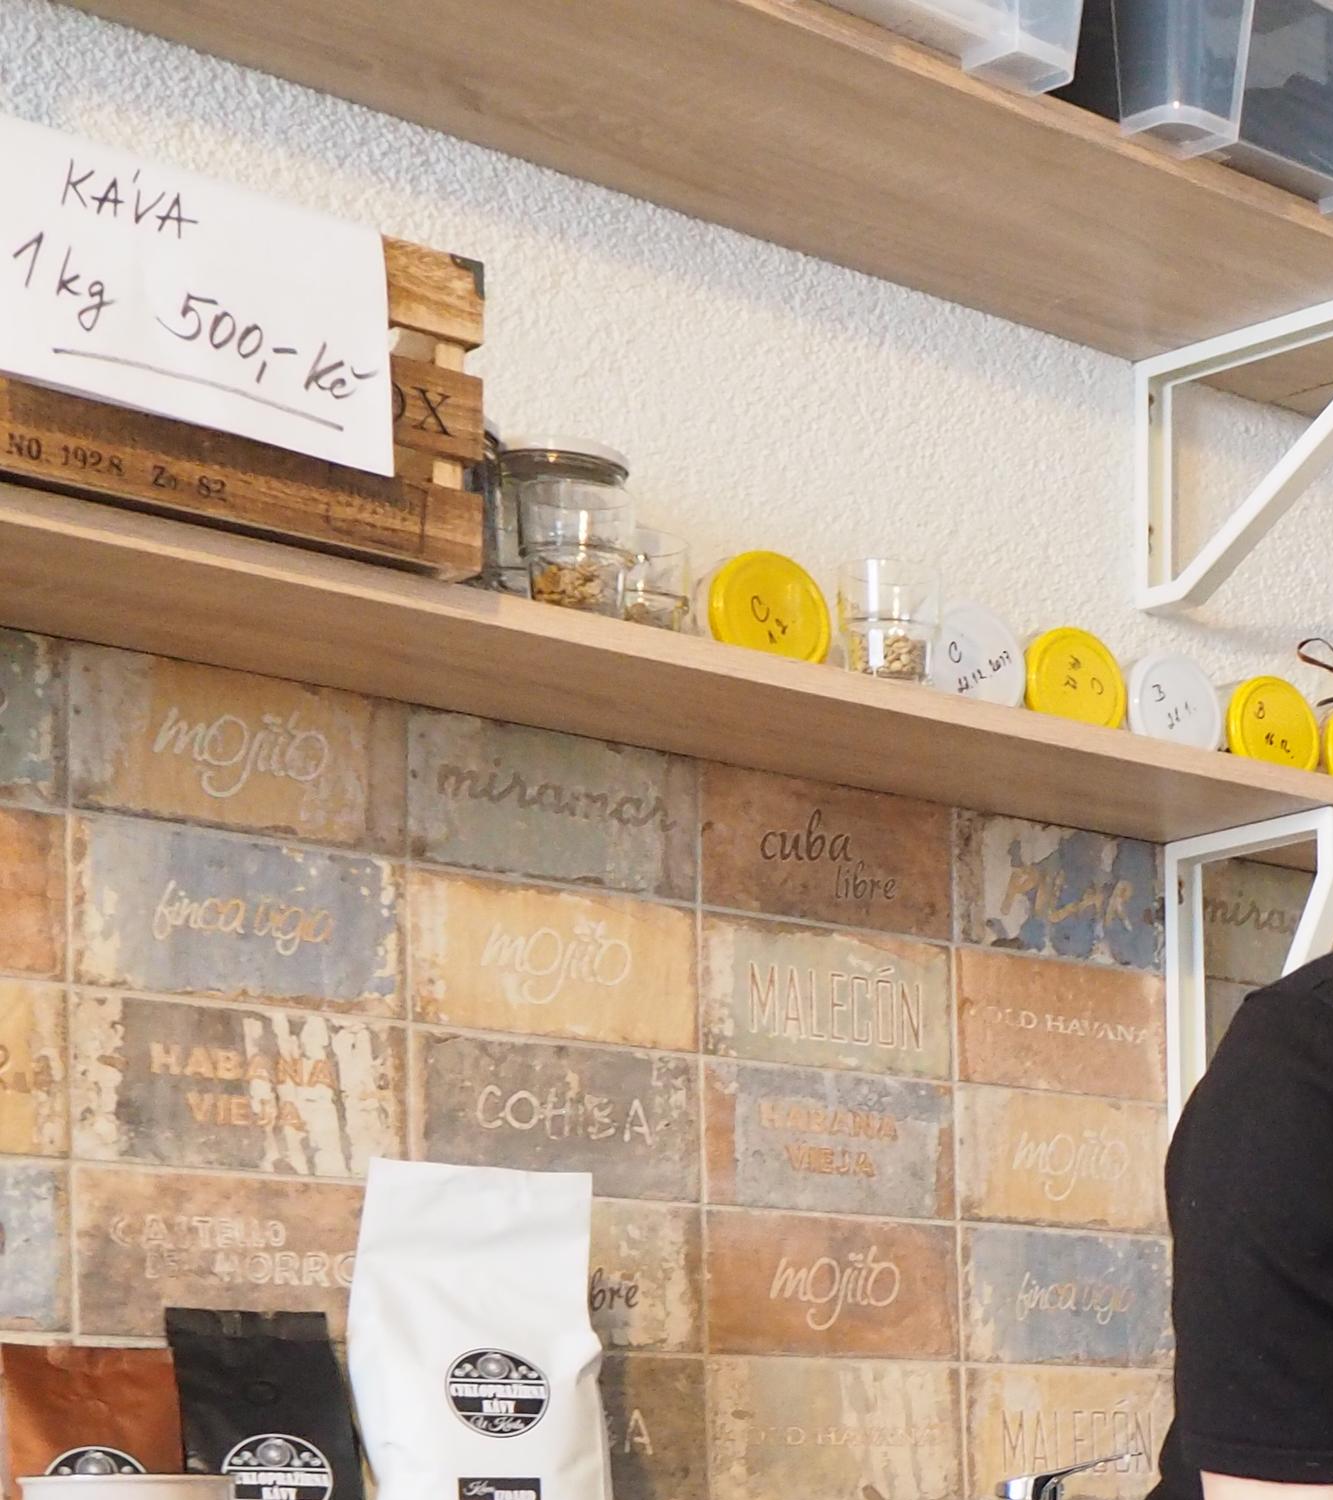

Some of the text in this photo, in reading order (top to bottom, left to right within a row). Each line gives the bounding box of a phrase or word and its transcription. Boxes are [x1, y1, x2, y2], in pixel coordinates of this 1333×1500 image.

[62, 159, 198, 239] KÁVA
[13, 232, 44, 288] 1
[56, 246, 116, 331] kg
[948, 640, 962, 664] C
[760, 809, 853, 863] cuba
[834, 856, 898, 901] libre
[1203, 889, 1292, 934] mira
[748, 961, 925, 1052] MALECÓN
[149, 1040, 340, 1091] HABANA
[185, 1092, 307, 1133] VIEJA
[758, 1100, 899, 1142] HABANA
[588, 1267, 639, 1311] bre
[769, 1245, 901, 1331] mojito
